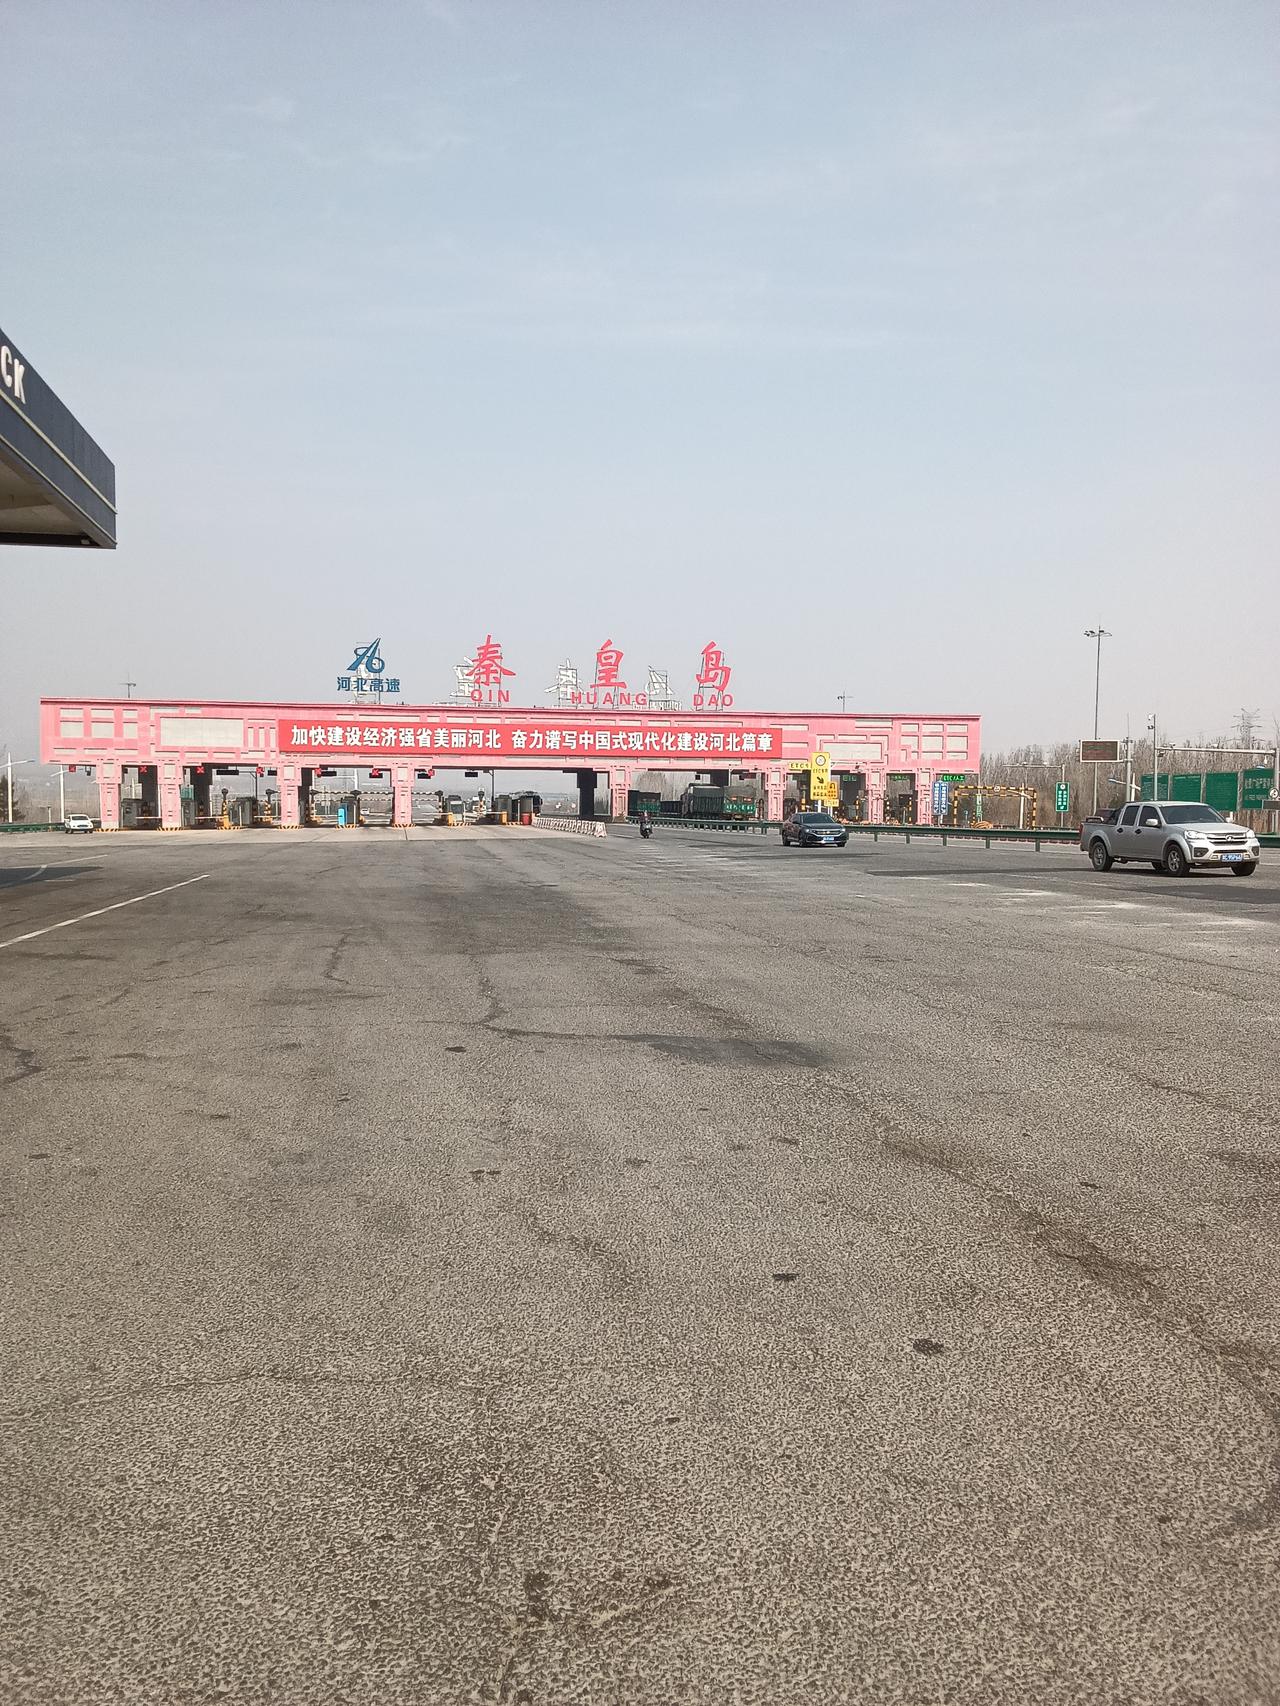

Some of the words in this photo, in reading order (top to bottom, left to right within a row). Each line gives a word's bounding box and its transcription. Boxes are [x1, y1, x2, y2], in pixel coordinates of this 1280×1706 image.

[1, 345, 26, 404] CK
[465, 633, 733, 692] 秦皇岛
[336, 676, 401, 693] 河北高速
[470, 688, 511, 703] QIN
[570, 691, 648, 706] HUANG
[693, 693, 734, 707] DAO
[290, 724, 502, 750] 加快建设经济强省美丽河北
[511, 729, 773, 753] 奋力谱写中国式现代化建设河北篇章
